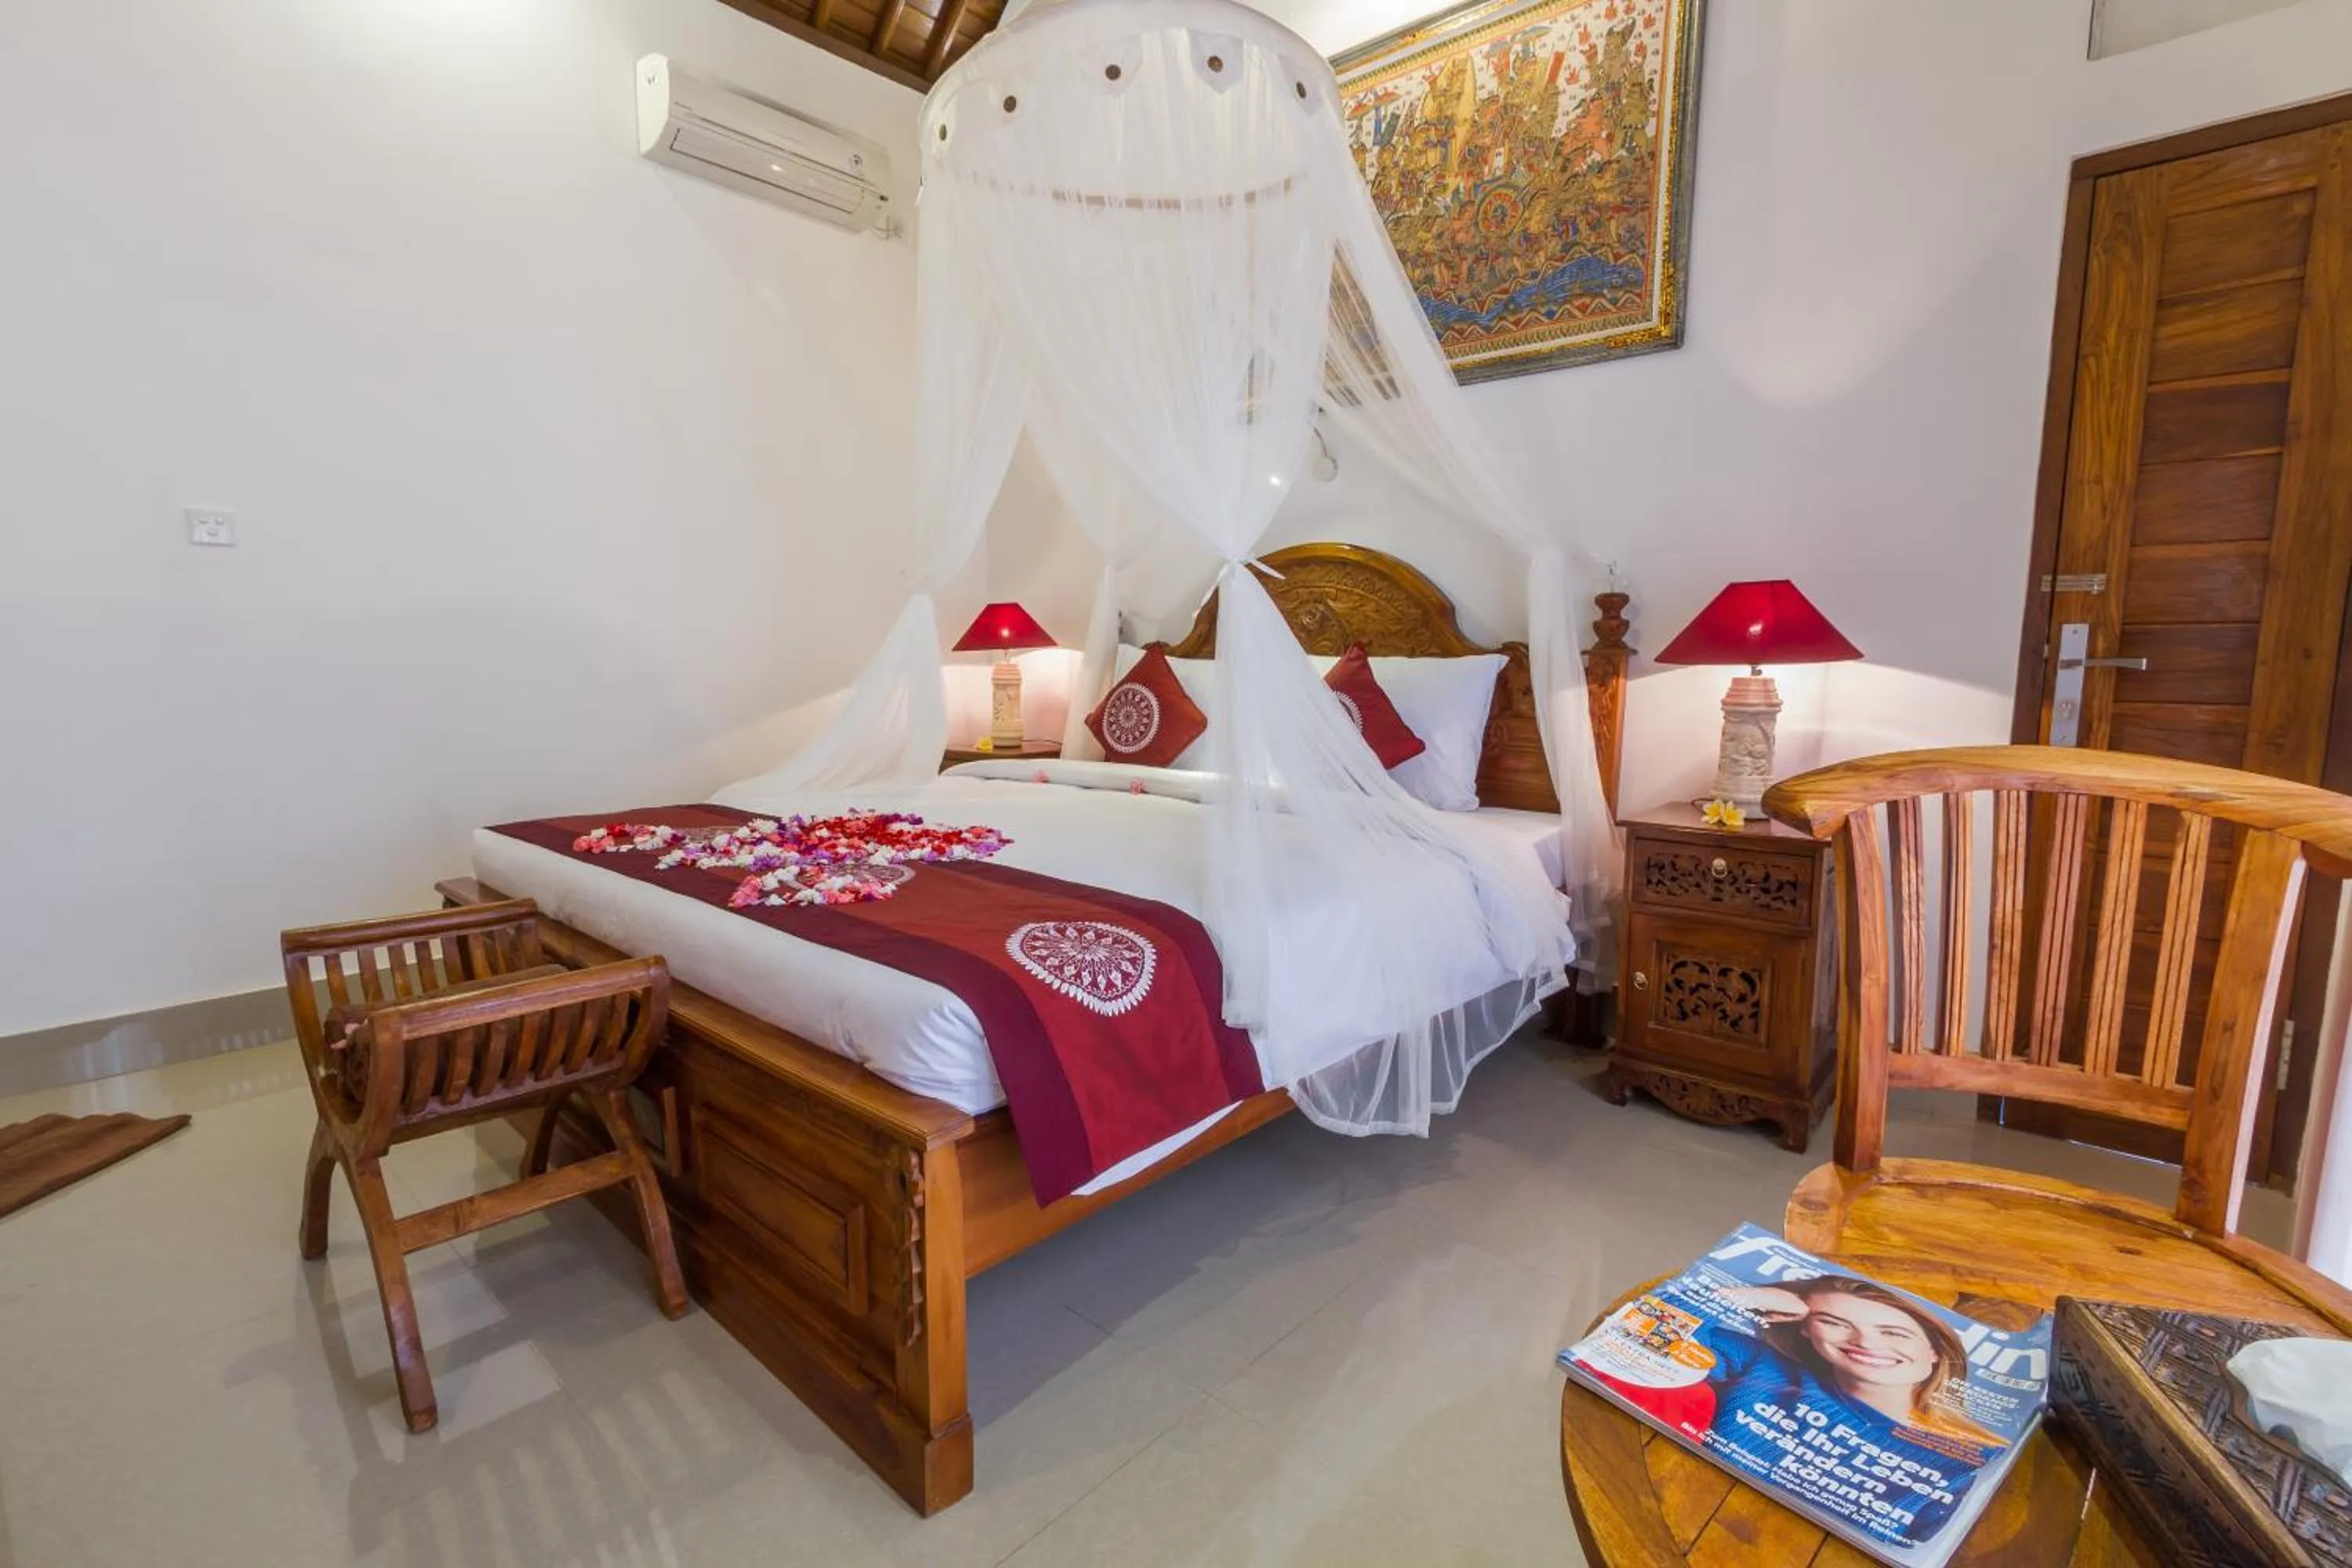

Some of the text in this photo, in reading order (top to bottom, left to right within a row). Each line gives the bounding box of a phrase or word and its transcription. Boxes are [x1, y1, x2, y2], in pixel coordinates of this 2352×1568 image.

[1735, 1409, 1888, 1494] verändern
[1753, 1402, 1955, 1504] die Ihr Leben
[1794, 1403, 1828, 1427] 10
[1831, 1424, 1948, 1487] Fragen,
[1773, 1467, 1802, 1485] Habe
[1820, 1491, 1858, 1512] genug
[1858, 1508, 1900, 1529] Spaß?
[1778, 1454, 1915, 1526] könnten
